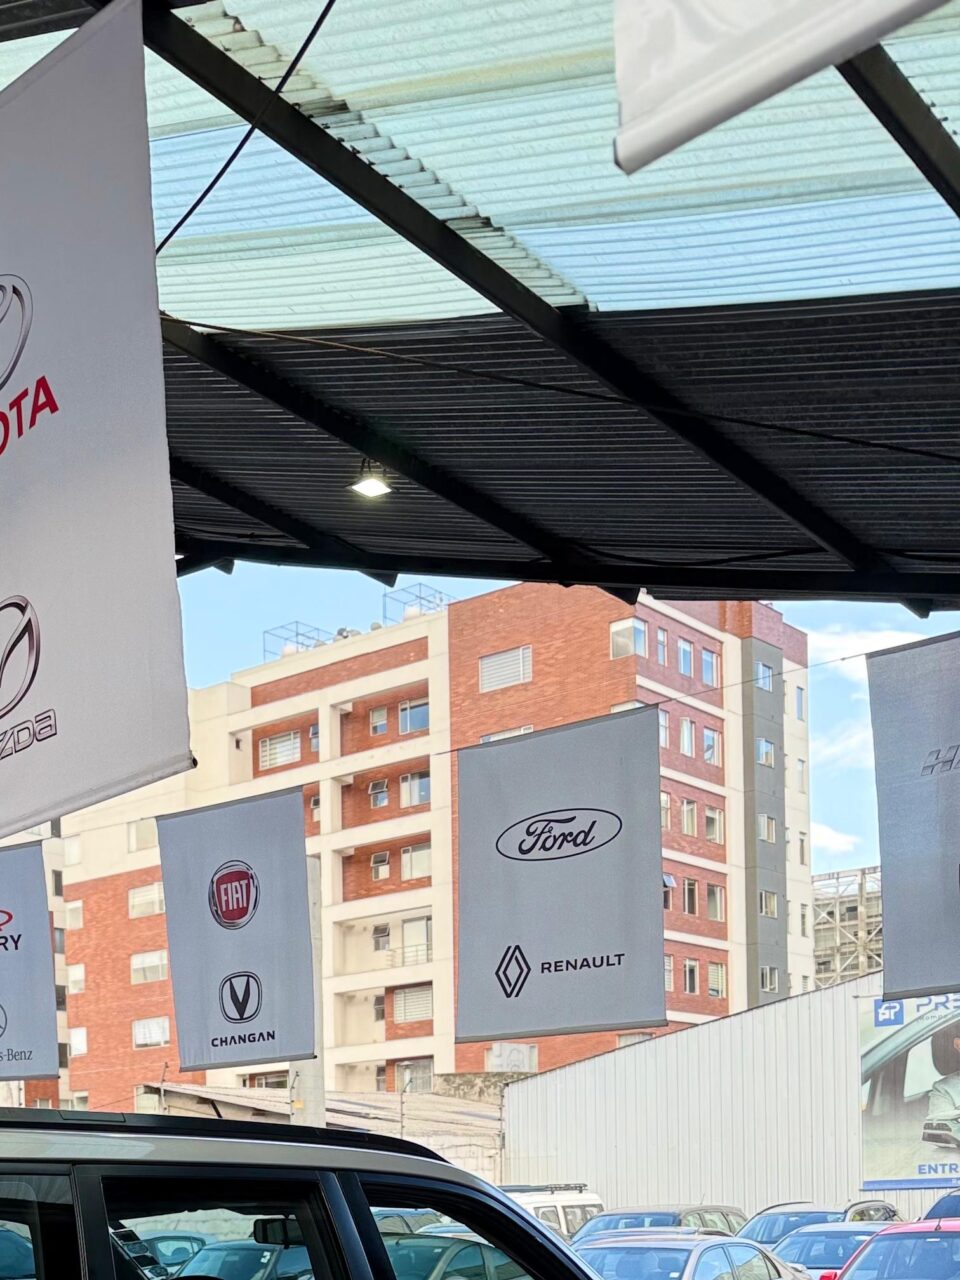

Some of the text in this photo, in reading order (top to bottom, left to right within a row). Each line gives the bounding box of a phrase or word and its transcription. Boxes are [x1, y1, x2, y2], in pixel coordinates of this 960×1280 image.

[517, 814, 597, 856] Ford
[219, 879, 249, 912] FIAT
[540, 952, 626, 975] RENAULT
[211, 1030, 276, 1048] CHANGAN
